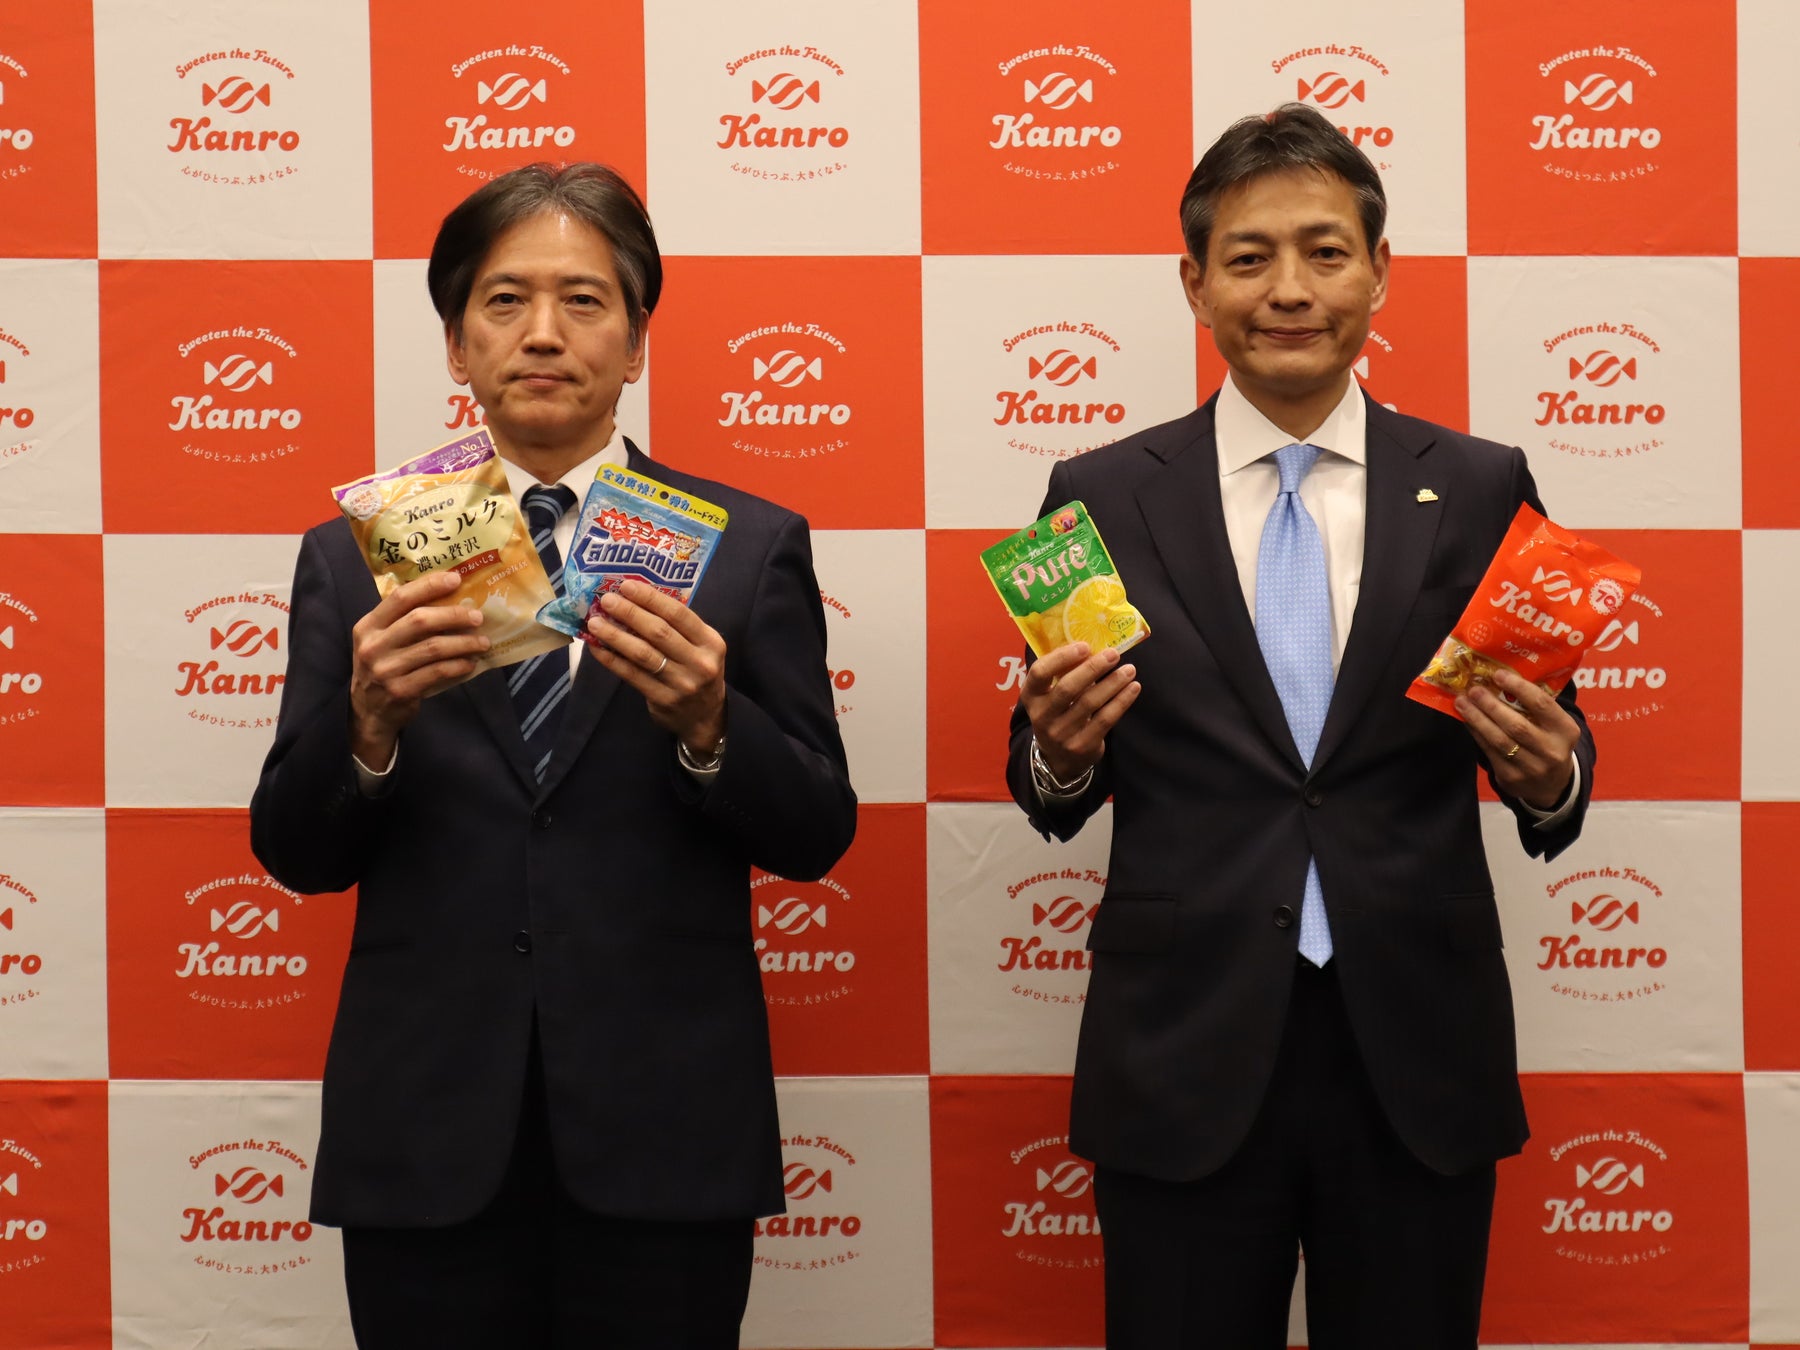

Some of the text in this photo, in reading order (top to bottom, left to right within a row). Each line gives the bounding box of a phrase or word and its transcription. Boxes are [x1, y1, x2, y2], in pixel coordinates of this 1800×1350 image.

[176, 48, 294, 79] Sweeten the Future
[452, 46, 569, 78] Sweeten the Future
[726, 45, 844, 76] Sweeten the Future
[998, 44, 1116, 76] Sweeten the Future
[1271, 44, 1389, 76] Sweeten the Future
[1538, 46, 1656, 77] Sweeten the Future
[167, 116, 300, 152] Kanro
[442, 115, 574, 151] Kanro
[717, 112, 850, 148] Kanro
[989, 113, 1122, 149] Kanro
[1529, 114, 1662, 150] Kanro
[178, 326, 295, 357] Sweeten the Future
[728, 322, 845, 353] Sweeten the Future
[1004, 320, 1121, 352] Sweeten the Future
[1544, 322, 1662, 353] Sweeten the Future
[168, 394, 300, 430] Kanro
[718, 390, 850, 426] Kanro
[994, 389, 1126, 425] Kanro
[1535, 390, 1668, 426] Kanro
[460, 435, 487, 455] No.1
[404, 498, 454, 524] Kanro
[377, 498, 497, 564] 金のミルク
[603, 516, 675, 549] カンデミーナ
[416, 536, 480, 573] 濃い贅沢
[572, 525, 700, 588] Candemina
[1028, 542, 1054, 558] Kanro
[184, 592, 292, 623] Sweeten the Futu
[1489, 580, 1585, 647] Kanro
[1630, 593, 1663, 617] uture
[1503, 639, 1540, 664] カンロ飴
[174, 660, 287, 696] Kanr
[1572, 667, 1667, 689] anro
[184, 877, 235, 905] Sweeten
[238, 873, 259, 885] the
[818, 877, 851, 901] uture
[1007, 871, 1057, 899] Sweeten
[1060, 868, 1081, 880] the
[1546, 866, 1664, 897] Sweeten the Future
[175, 941, 308, 977] Kanro
[754, 938, 855, 973] anro
[997, 936, 1094, 972] Kan
[1537, 934, 1670, 970] Kanro
[1, 1139, 42, 1169] Future
[189, 1139, 307, 1170] Sweeten the Future
[791, 1135, 812, 1147] the
[814, 1136, 856, 1166] Future
[1010, 1136, 1061, 1165] Sweeten
[1550, 1129, 1667, 1161] Sweeten the Future
[180, 1206, 312, 1242] Kanro
[1542, 1197, 1674, 1233] Kanro
